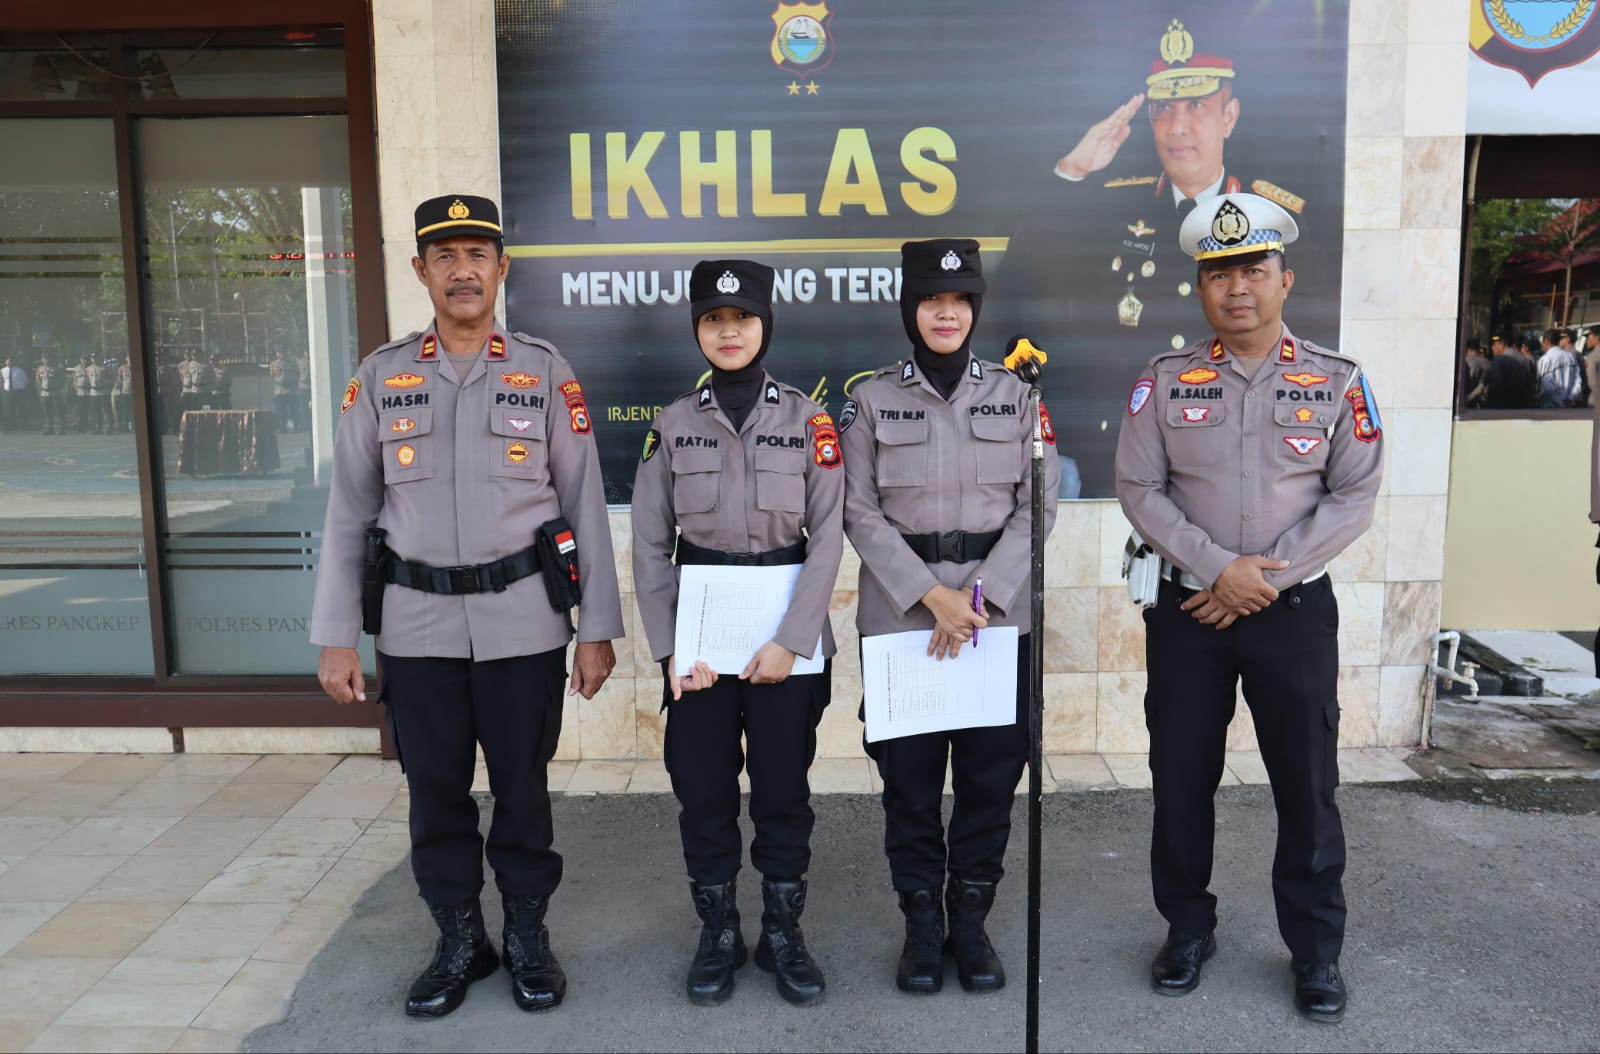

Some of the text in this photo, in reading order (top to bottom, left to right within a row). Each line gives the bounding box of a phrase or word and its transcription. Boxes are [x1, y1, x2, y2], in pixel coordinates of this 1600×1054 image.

[570, 127, 959, 219] IKHLAS
[771, 268, 817, 303] NG
[825, 267, 903, 303] TER
[495, 392, 545, 409] POLRI
[1170, 387, 1223, 400] M.SALEH
[1276, 389, 1332, 402] POLRI
[382, 393, 429, 410] HASRI
[608, 406, 651, 421] IRJEN
[879, 409, 926, 421] TRI M.N
[969, 403, 1017, 416] POLRI
[675, 436, 718, 449] RATIH
[756, 434, 805, 449] POLRI
[47, 615, 140, 631] PANGKEP
[187, 616, 307, 632] POLRES PAN
